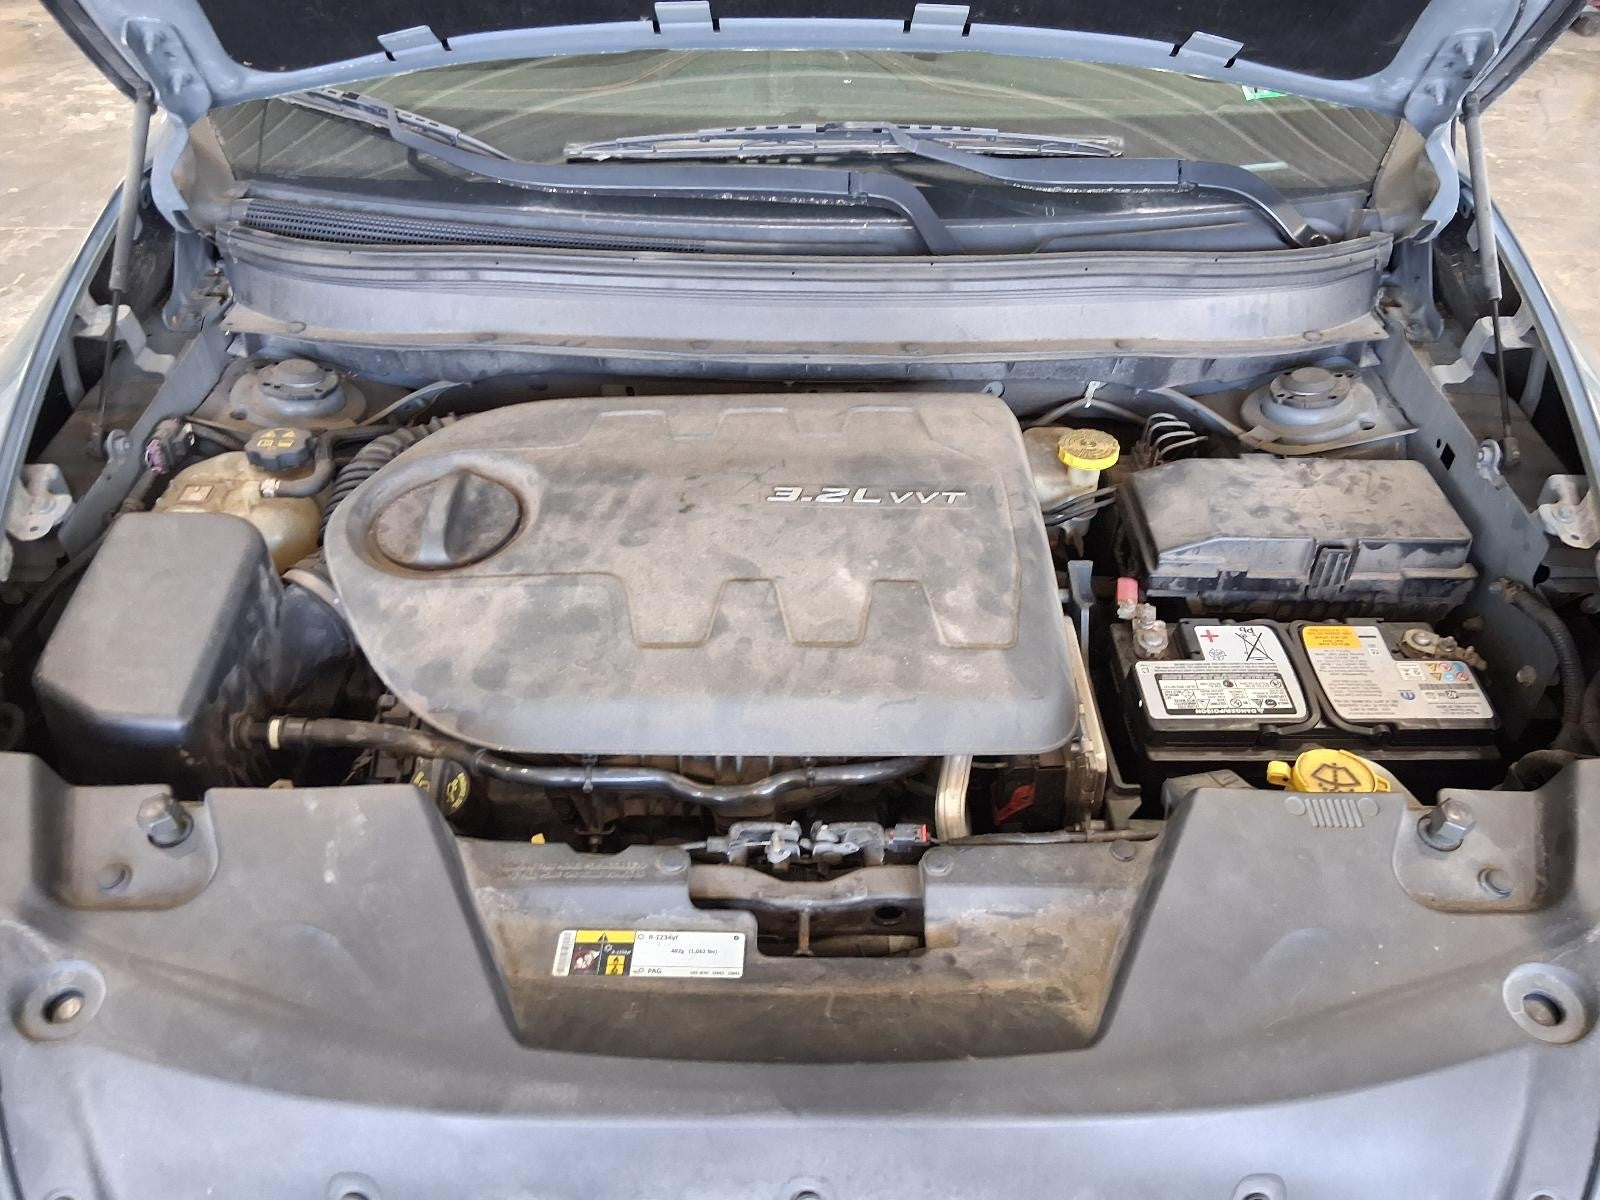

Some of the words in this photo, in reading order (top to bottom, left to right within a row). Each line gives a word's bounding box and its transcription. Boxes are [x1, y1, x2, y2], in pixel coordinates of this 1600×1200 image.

[766, 486, 882, 504] 3.2L
[889, 491, 967, 505] VVT
[1239, 627, 1254, 635] Pb
[647, 967, 662, 975] PAG
